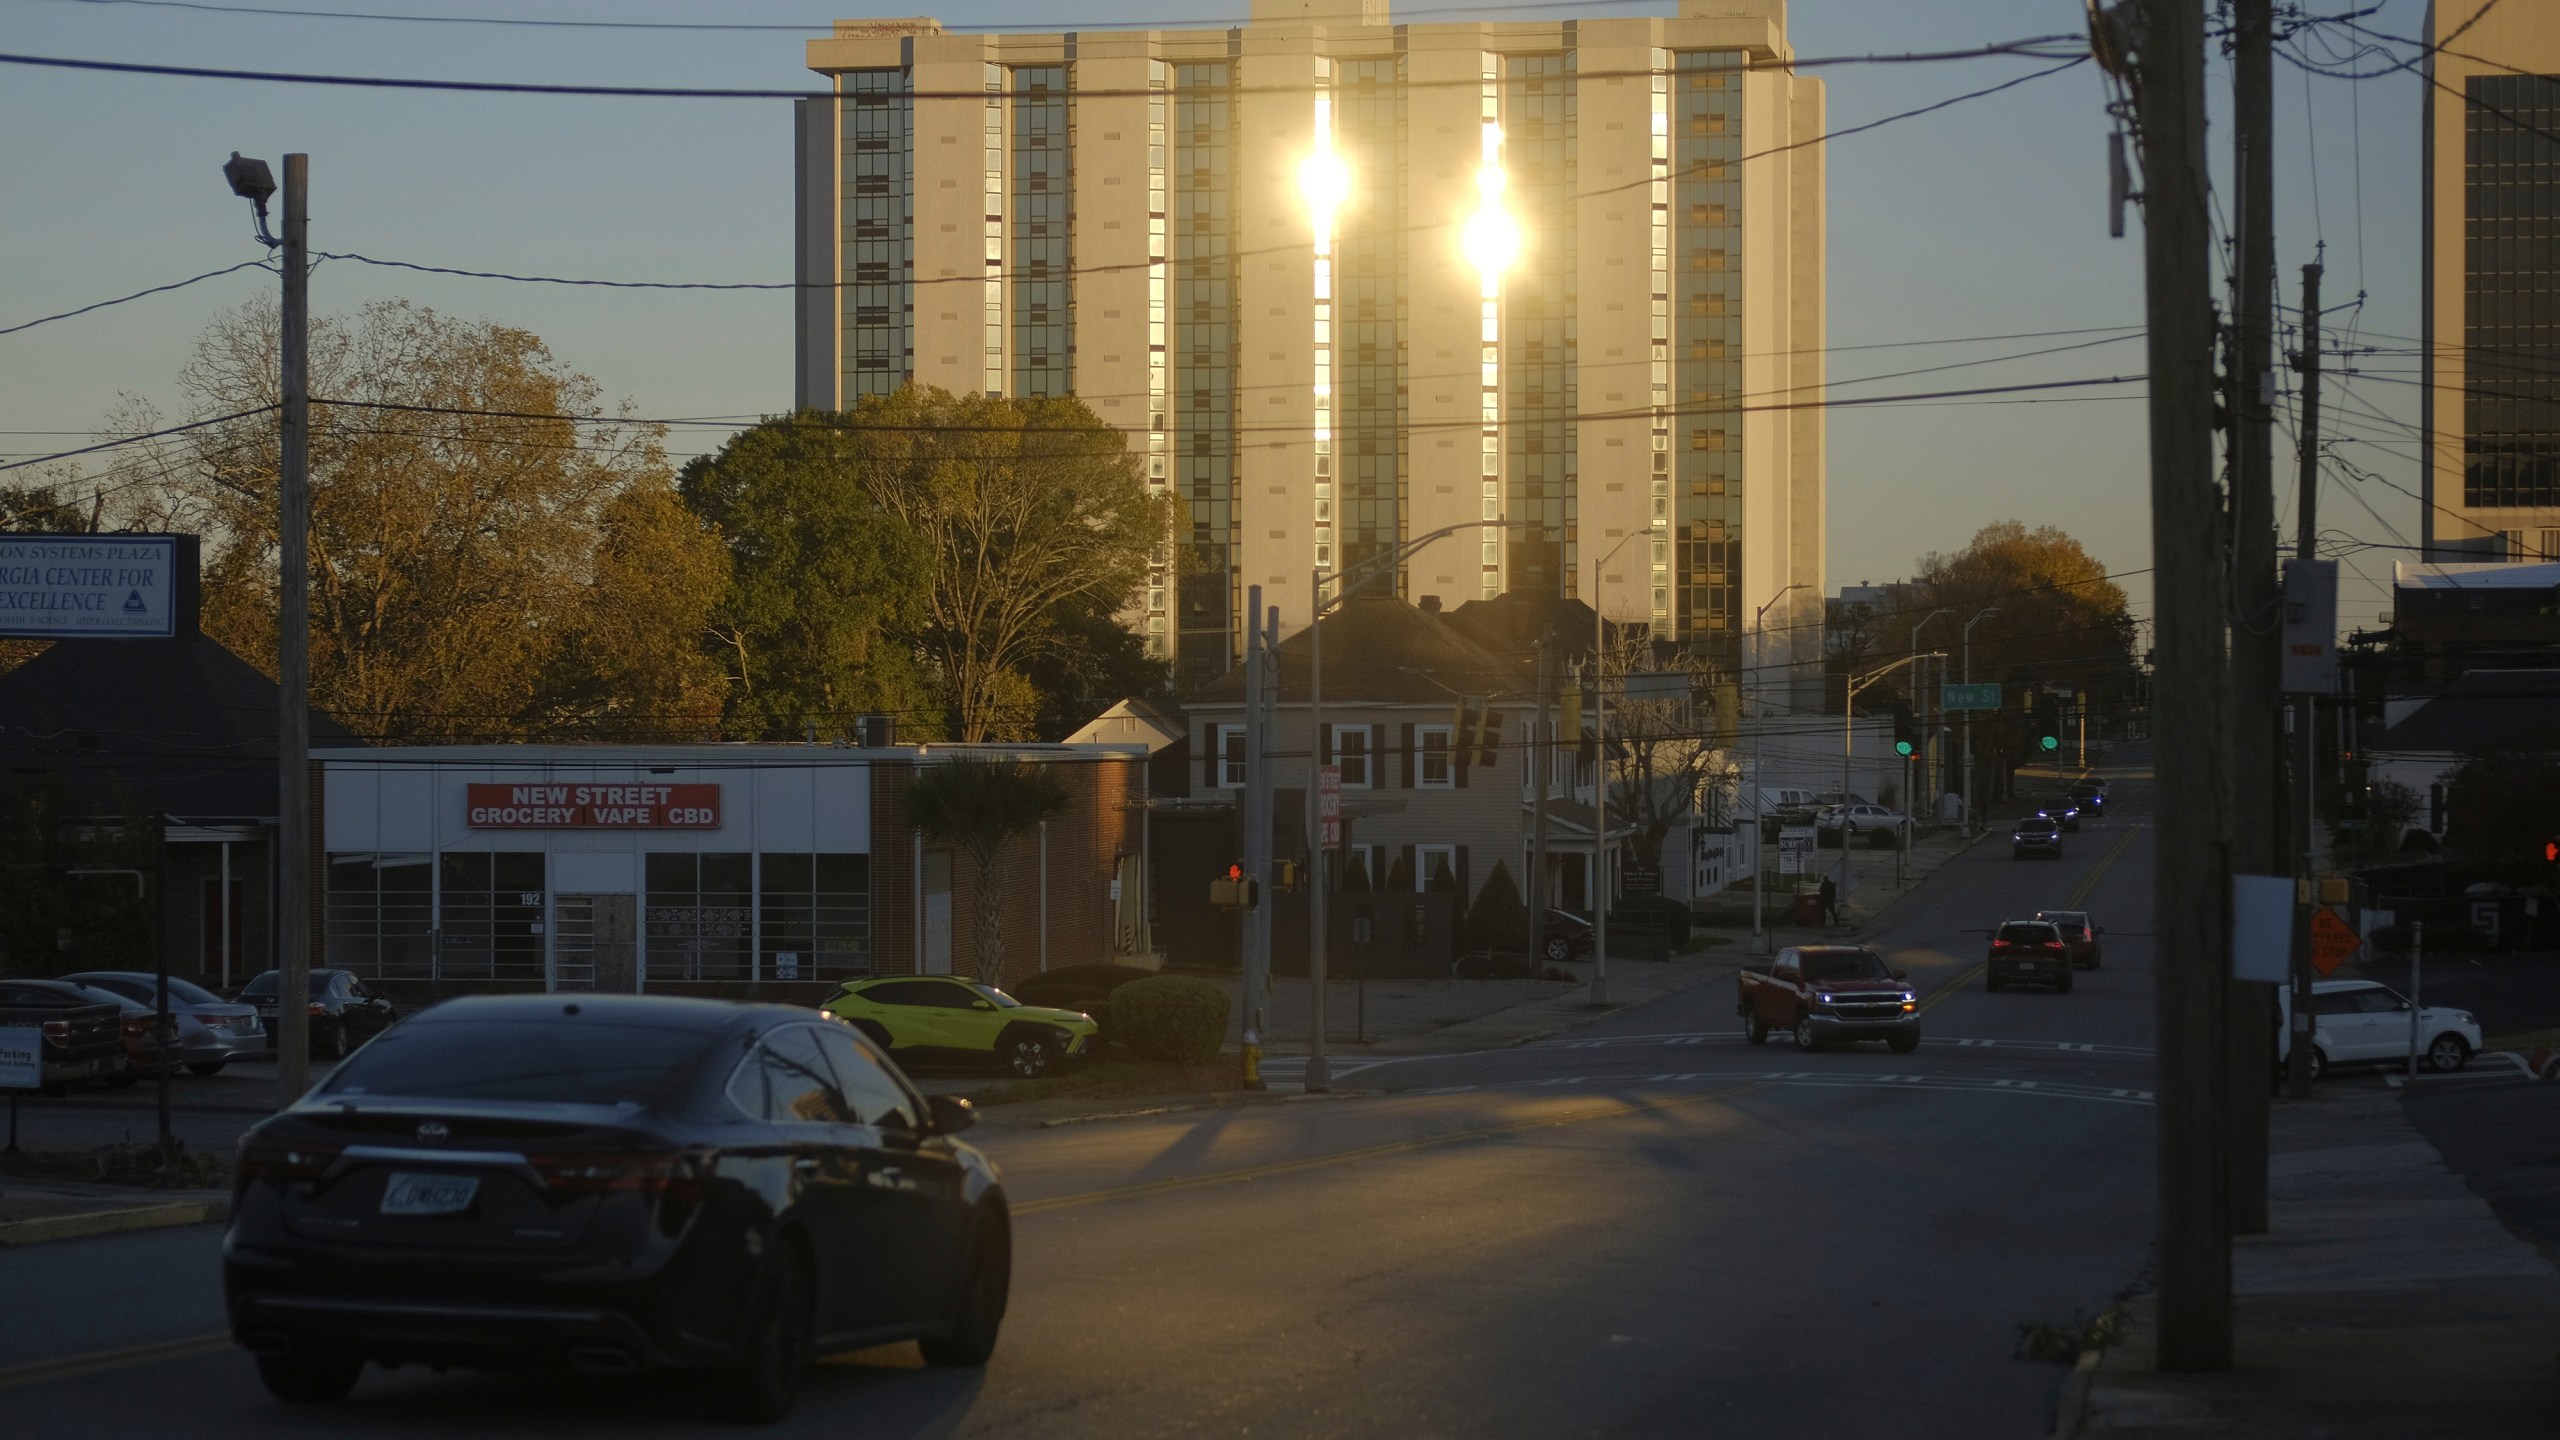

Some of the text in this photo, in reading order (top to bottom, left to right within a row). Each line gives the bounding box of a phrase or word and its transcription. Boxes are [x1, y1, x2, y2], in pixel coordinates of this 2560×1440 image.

[31, 546, 103, 560] SYSTEMS
[107, 547, 161, 561] PLAZA
[46, 568, 112, 586] CENTER
[118, 569, 154, 587] FOR
[0, 591, 107, 610] EXCELLENCE
[1947, 690, 1996, 703] New St
[512, 787, 672, 805] NEW STREET
[471, 807, 714, 824] GROCERY VAPE CBD
[520, 893, 540, 906] 192
[2320, 918, 2333, 928] BE
